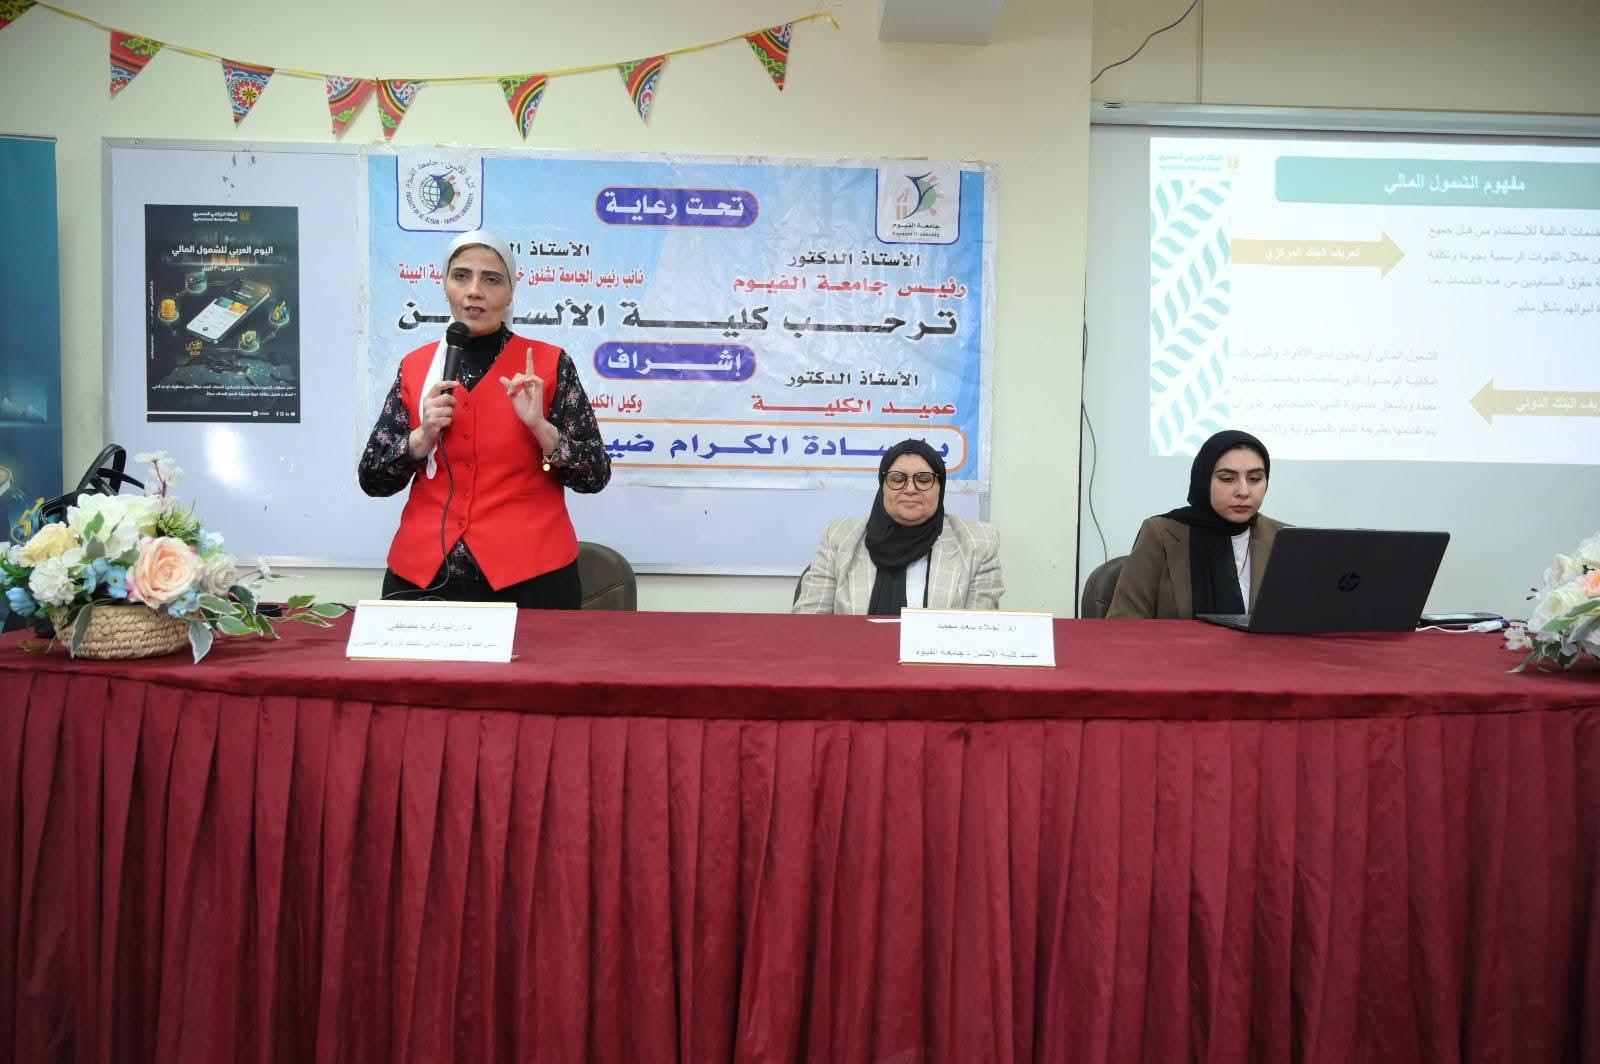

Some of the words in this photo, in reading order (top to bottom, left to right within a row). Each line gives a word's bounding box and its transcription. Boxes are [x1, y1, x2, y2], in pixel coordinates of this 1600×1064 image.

[1384, 172, 1425, 195] المالي
[1429, 173, 1479, 193] الشمول
[1483, 175, 1526, 195] مفهوم
[604, 191, 678, 221] رعاية
[686, 196, 745, 217] تحت
[171, 244, 195, 256] المالي
[197, 244, 227, 254] للشمول
[229, 246, 252, 257] العربي
[253, 246, 274, 256] اليوم
[530, 240, 590, 258] الأستاذ
[785, 249, 853, 268] الدكتور
[861, 249, 921, 267] الأستاذ
[559, 266, 593, 287] الجامعة
[595, 268, 620, 288] رئيس
[622, 268, 644, 288] نائب
[733, 273, 807, 294] الفيوم
[816, 273, 889, 296] جامعة
[897, 278, 967, 298] رئيس
[619, 300, 769, 338] كلية
[784, 310, 957, 341] ترحب
[607, 348, 741, 377] إشراف
[783, 370, 851, 388] الدكتور
[859, 370, 918, 387] الأستاذ
[618, 394, 643, 413] وكيل
[751, 394, 872, 417] الكلية
[881, 400, 956, 419] عميد
[670, 433, 788, 459] الكرام
